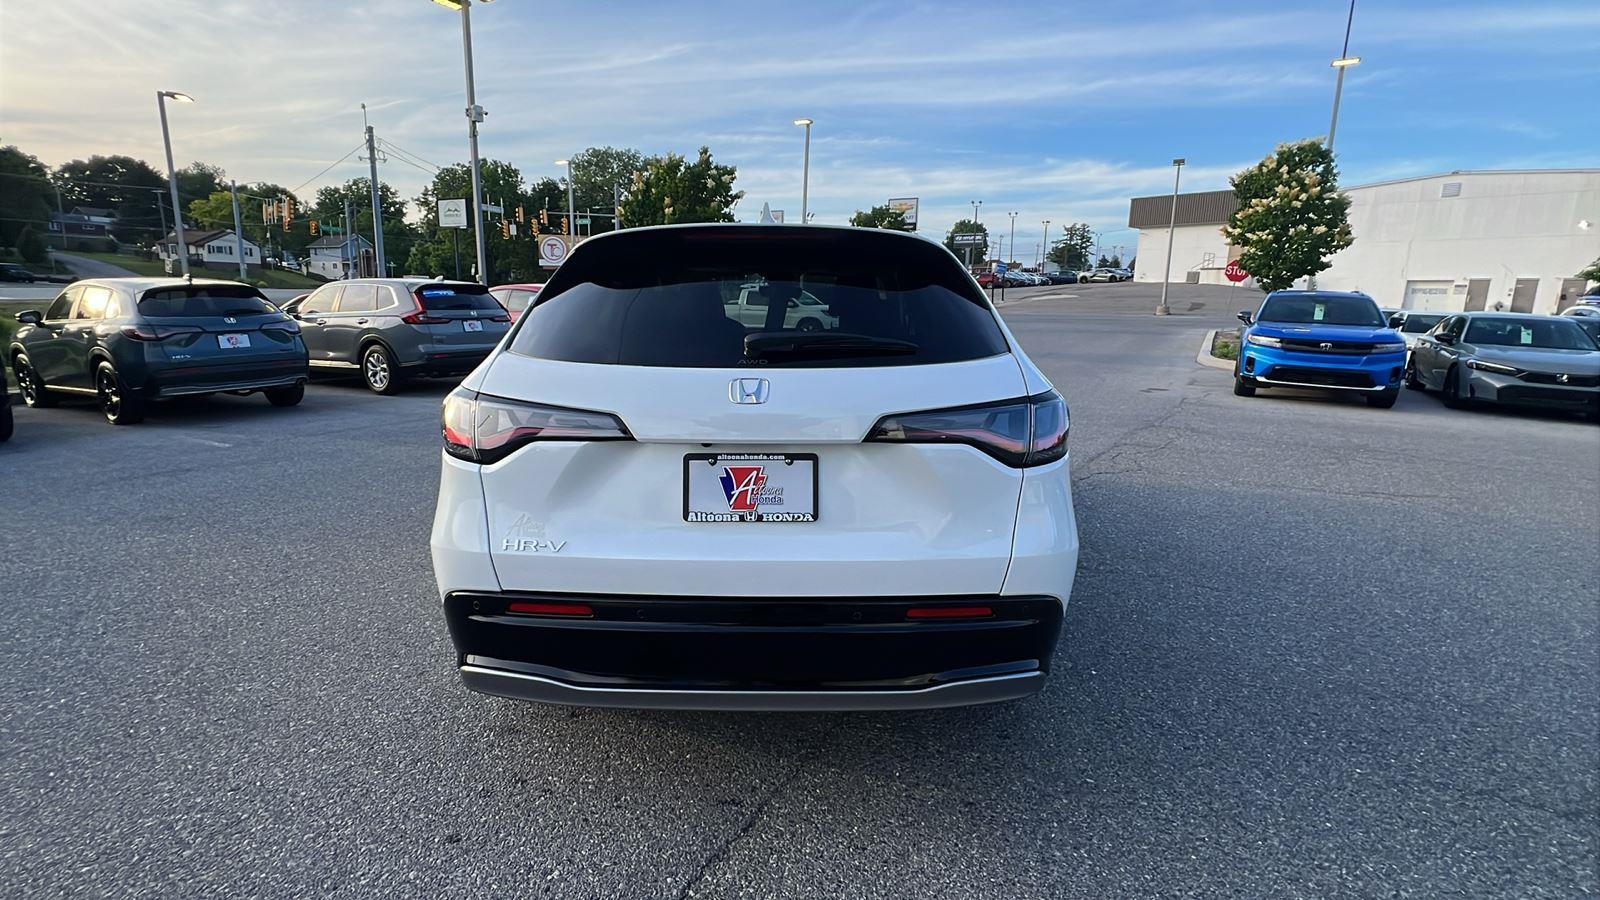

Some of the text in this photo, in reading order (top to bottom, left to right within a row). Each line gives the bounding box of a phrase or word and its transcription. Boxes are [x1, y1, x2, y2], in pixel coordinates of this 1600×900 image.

[751, 494, 783, 504] Honda
[687, 511, 814, 522] Altoona HONDA
[502, 538, 566, 552] HR-V
